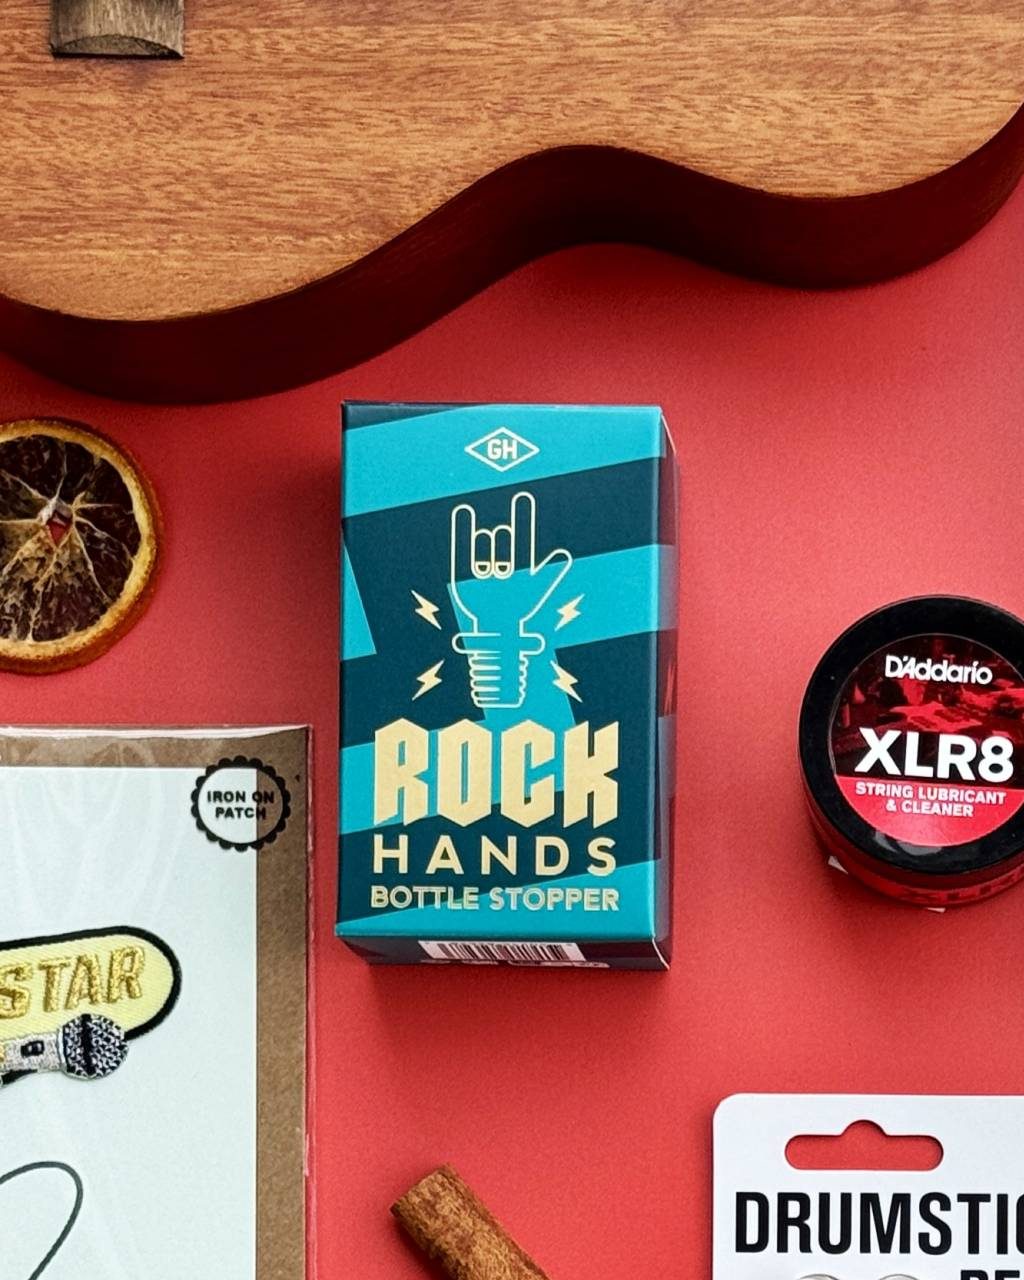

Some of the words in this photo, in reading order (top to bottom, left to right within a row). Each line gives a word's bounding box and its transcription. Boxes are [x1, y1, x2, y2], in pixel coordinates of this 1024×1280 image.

[487, 439, 518, 460] GH
[855, 727, 1014, 783] XLR8
[374, 718, 619, 828] ROCK
[207, 790, 246, 803] IRON
[251, 790, 275, 803] ON
[855, 782, 913, 799] STRING
[918, 787, 1006, 805] LUBRICANT
[215, 806, 267, 820] PATCH
[886, 799, 897, 812] &
[901, 801, 974, 817] CLEANER
[373, 834, 617, 877] HANDS
[370, 886, 479, 910] BOTTLE
[489, 887, 619, 911] STOPPER
